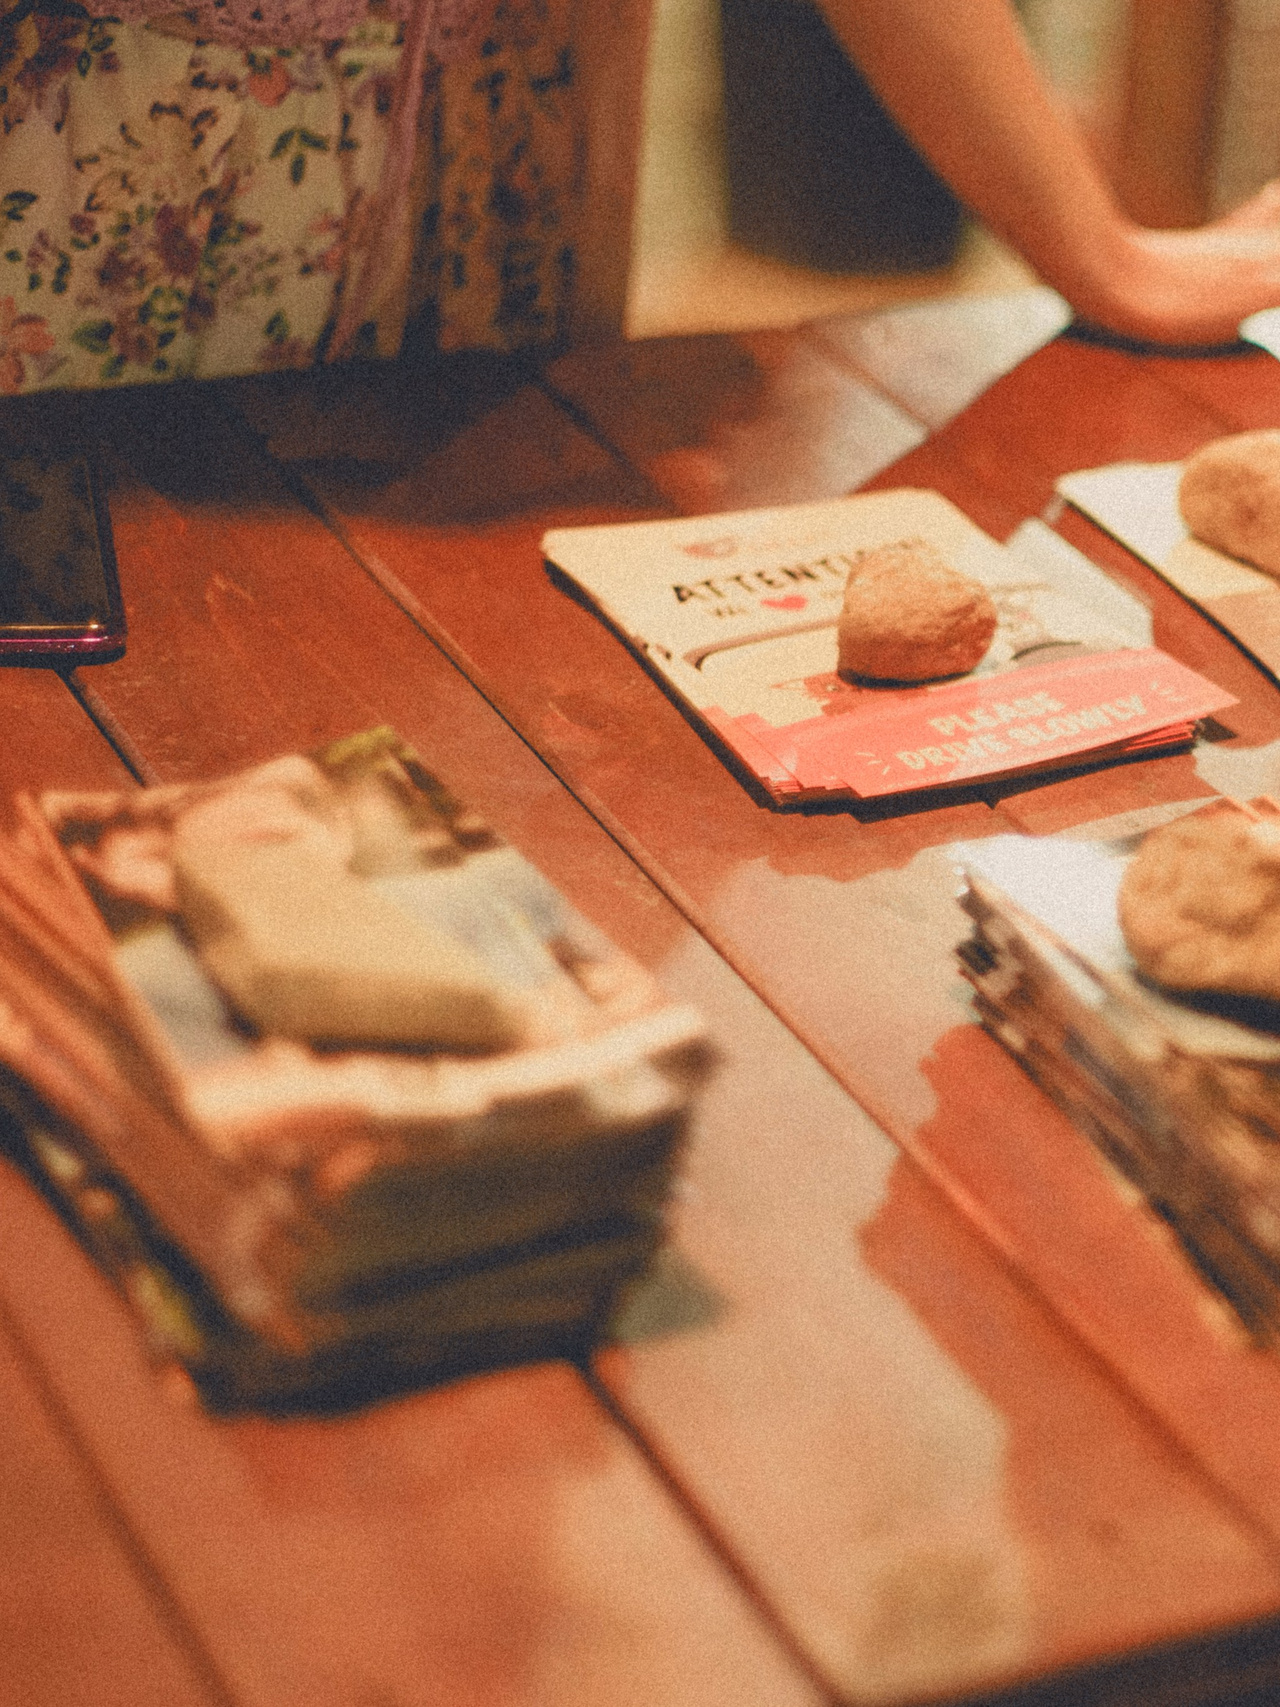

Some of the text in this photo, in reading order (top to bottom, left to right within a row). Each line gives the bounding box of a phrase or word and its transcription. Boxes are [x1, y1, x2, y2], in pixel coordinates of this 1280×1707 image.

[895, 694, 1147, 771] DRIVE SLOWLY
[928, 692, 1064, 736] PLEASE
